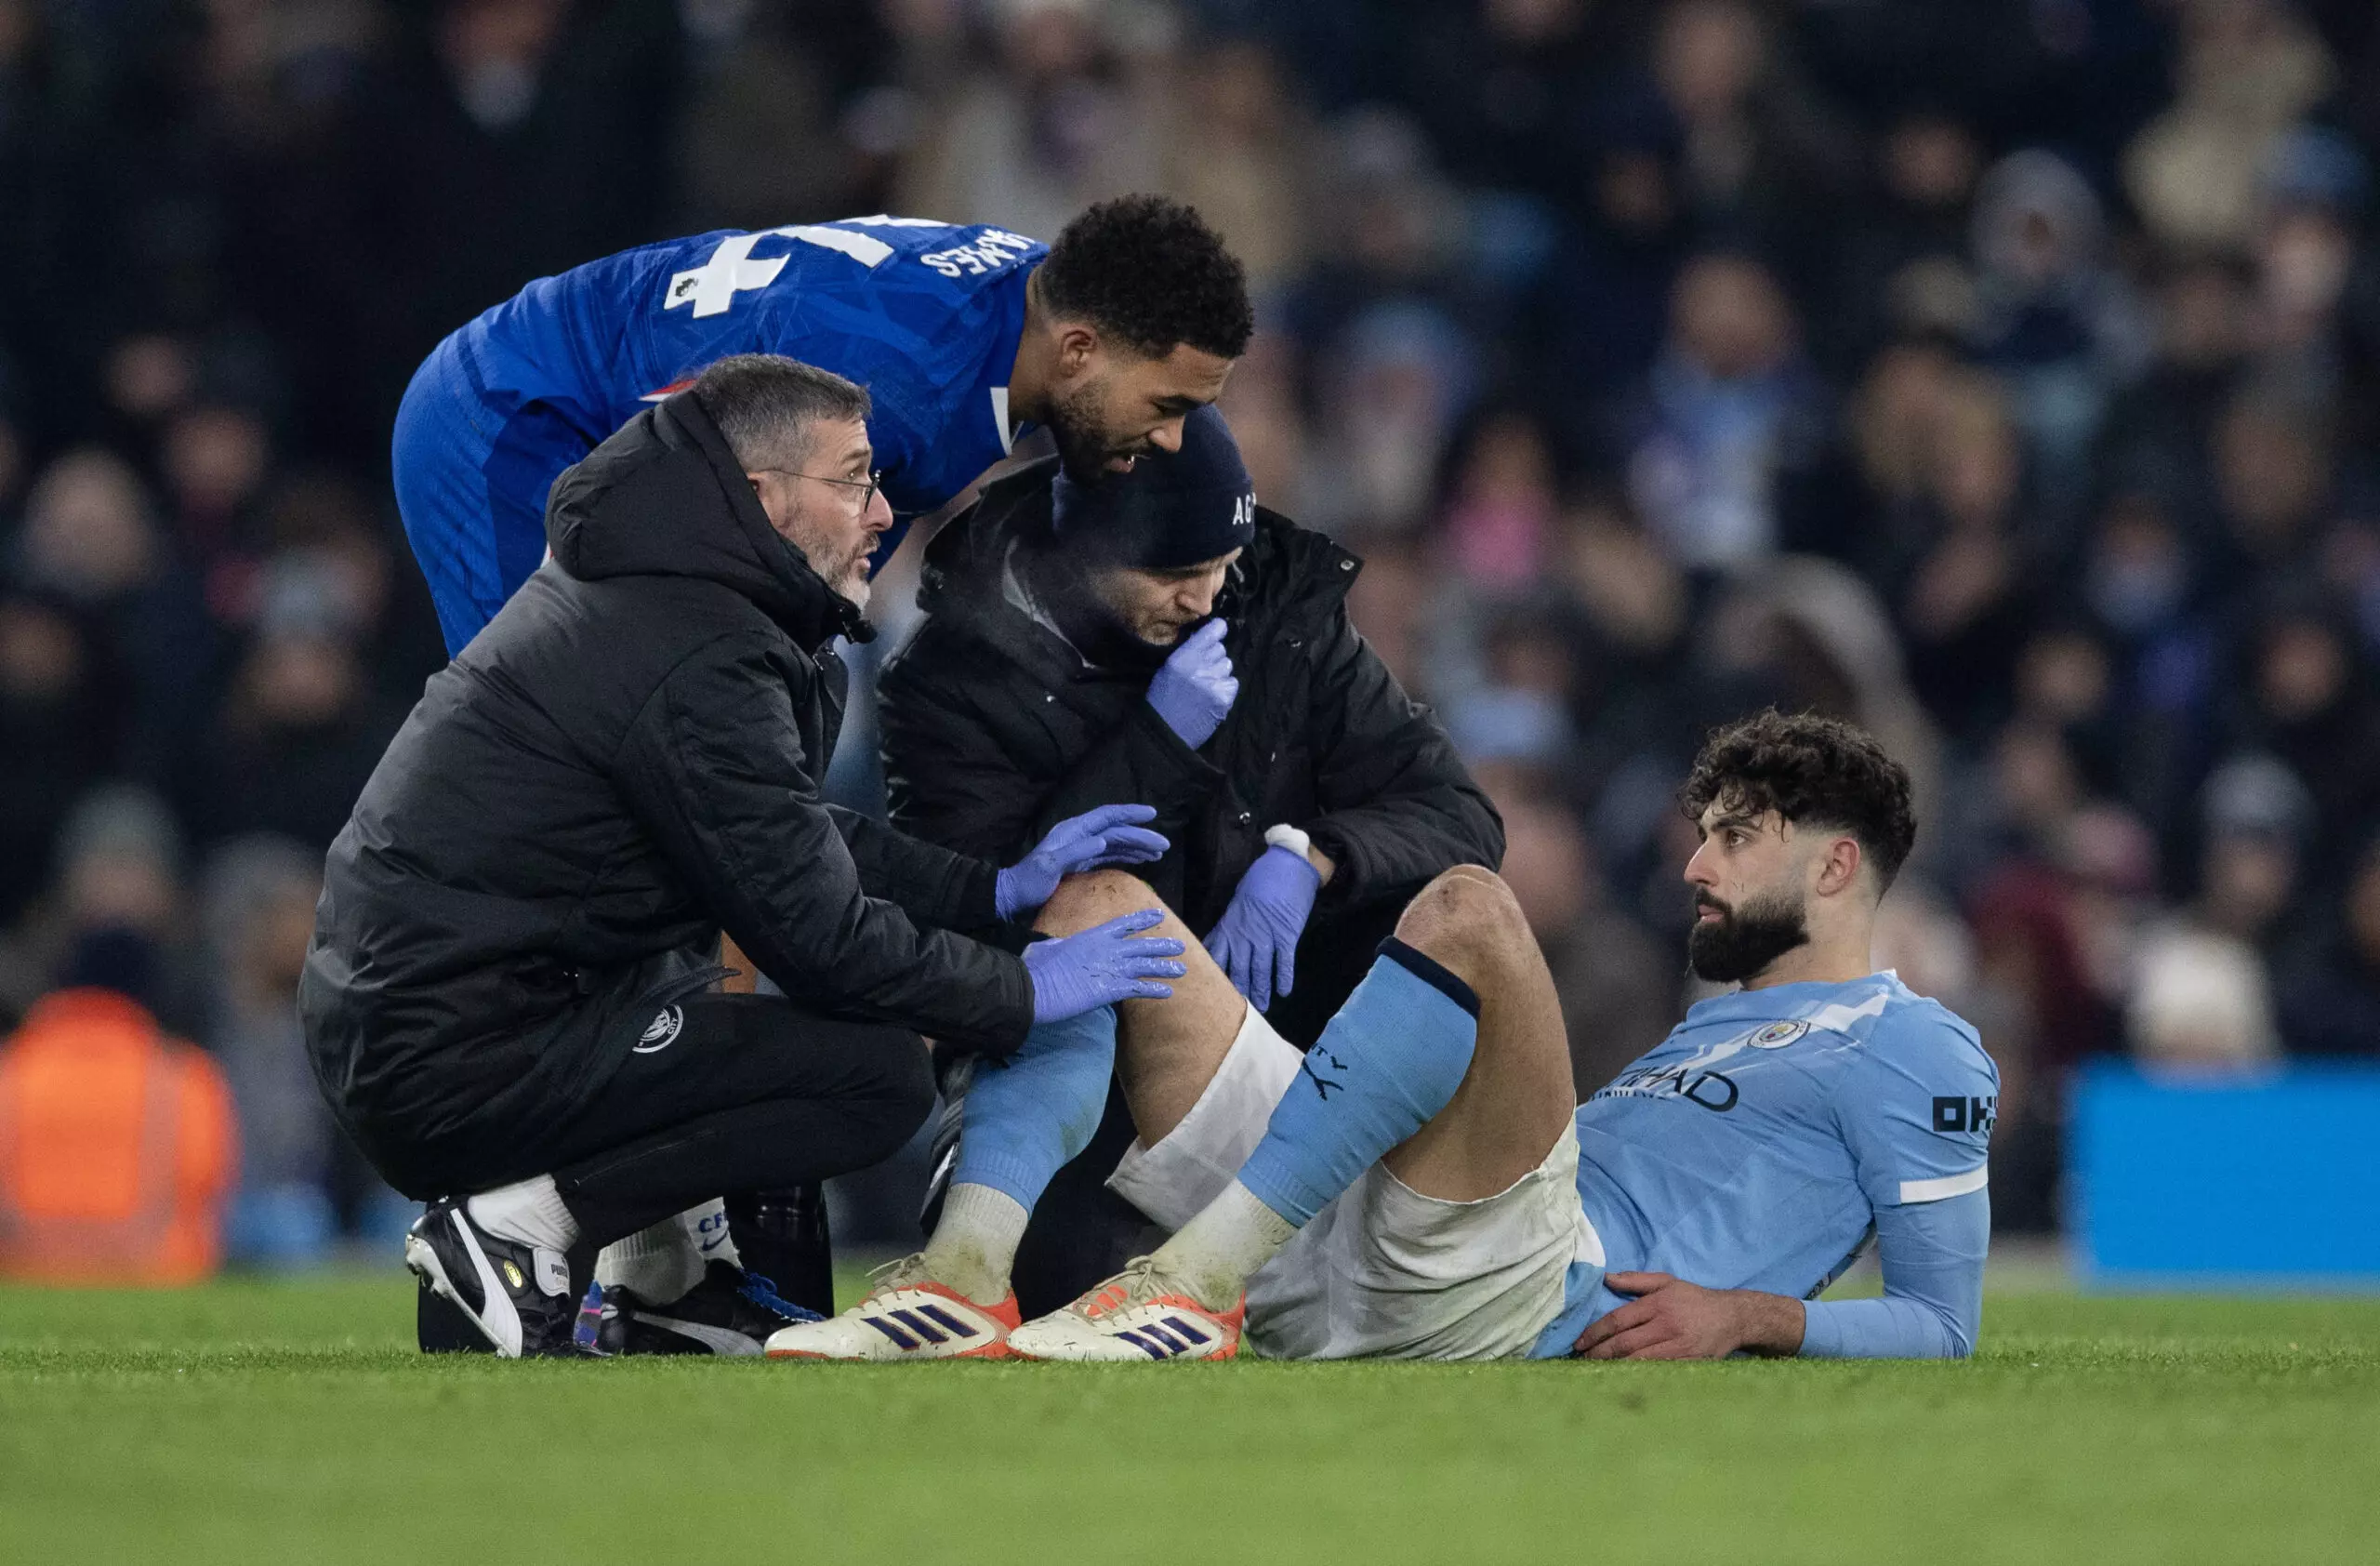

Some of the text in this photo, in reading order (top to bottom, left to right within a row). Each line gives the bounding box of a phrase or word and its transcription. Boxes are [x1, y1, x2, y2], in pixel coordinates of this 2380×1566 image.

[920, 229, 1036, 277] AMES
[1933, 1096, 1997, 1133] OK
[698, 1212, 724, 1233] CF
